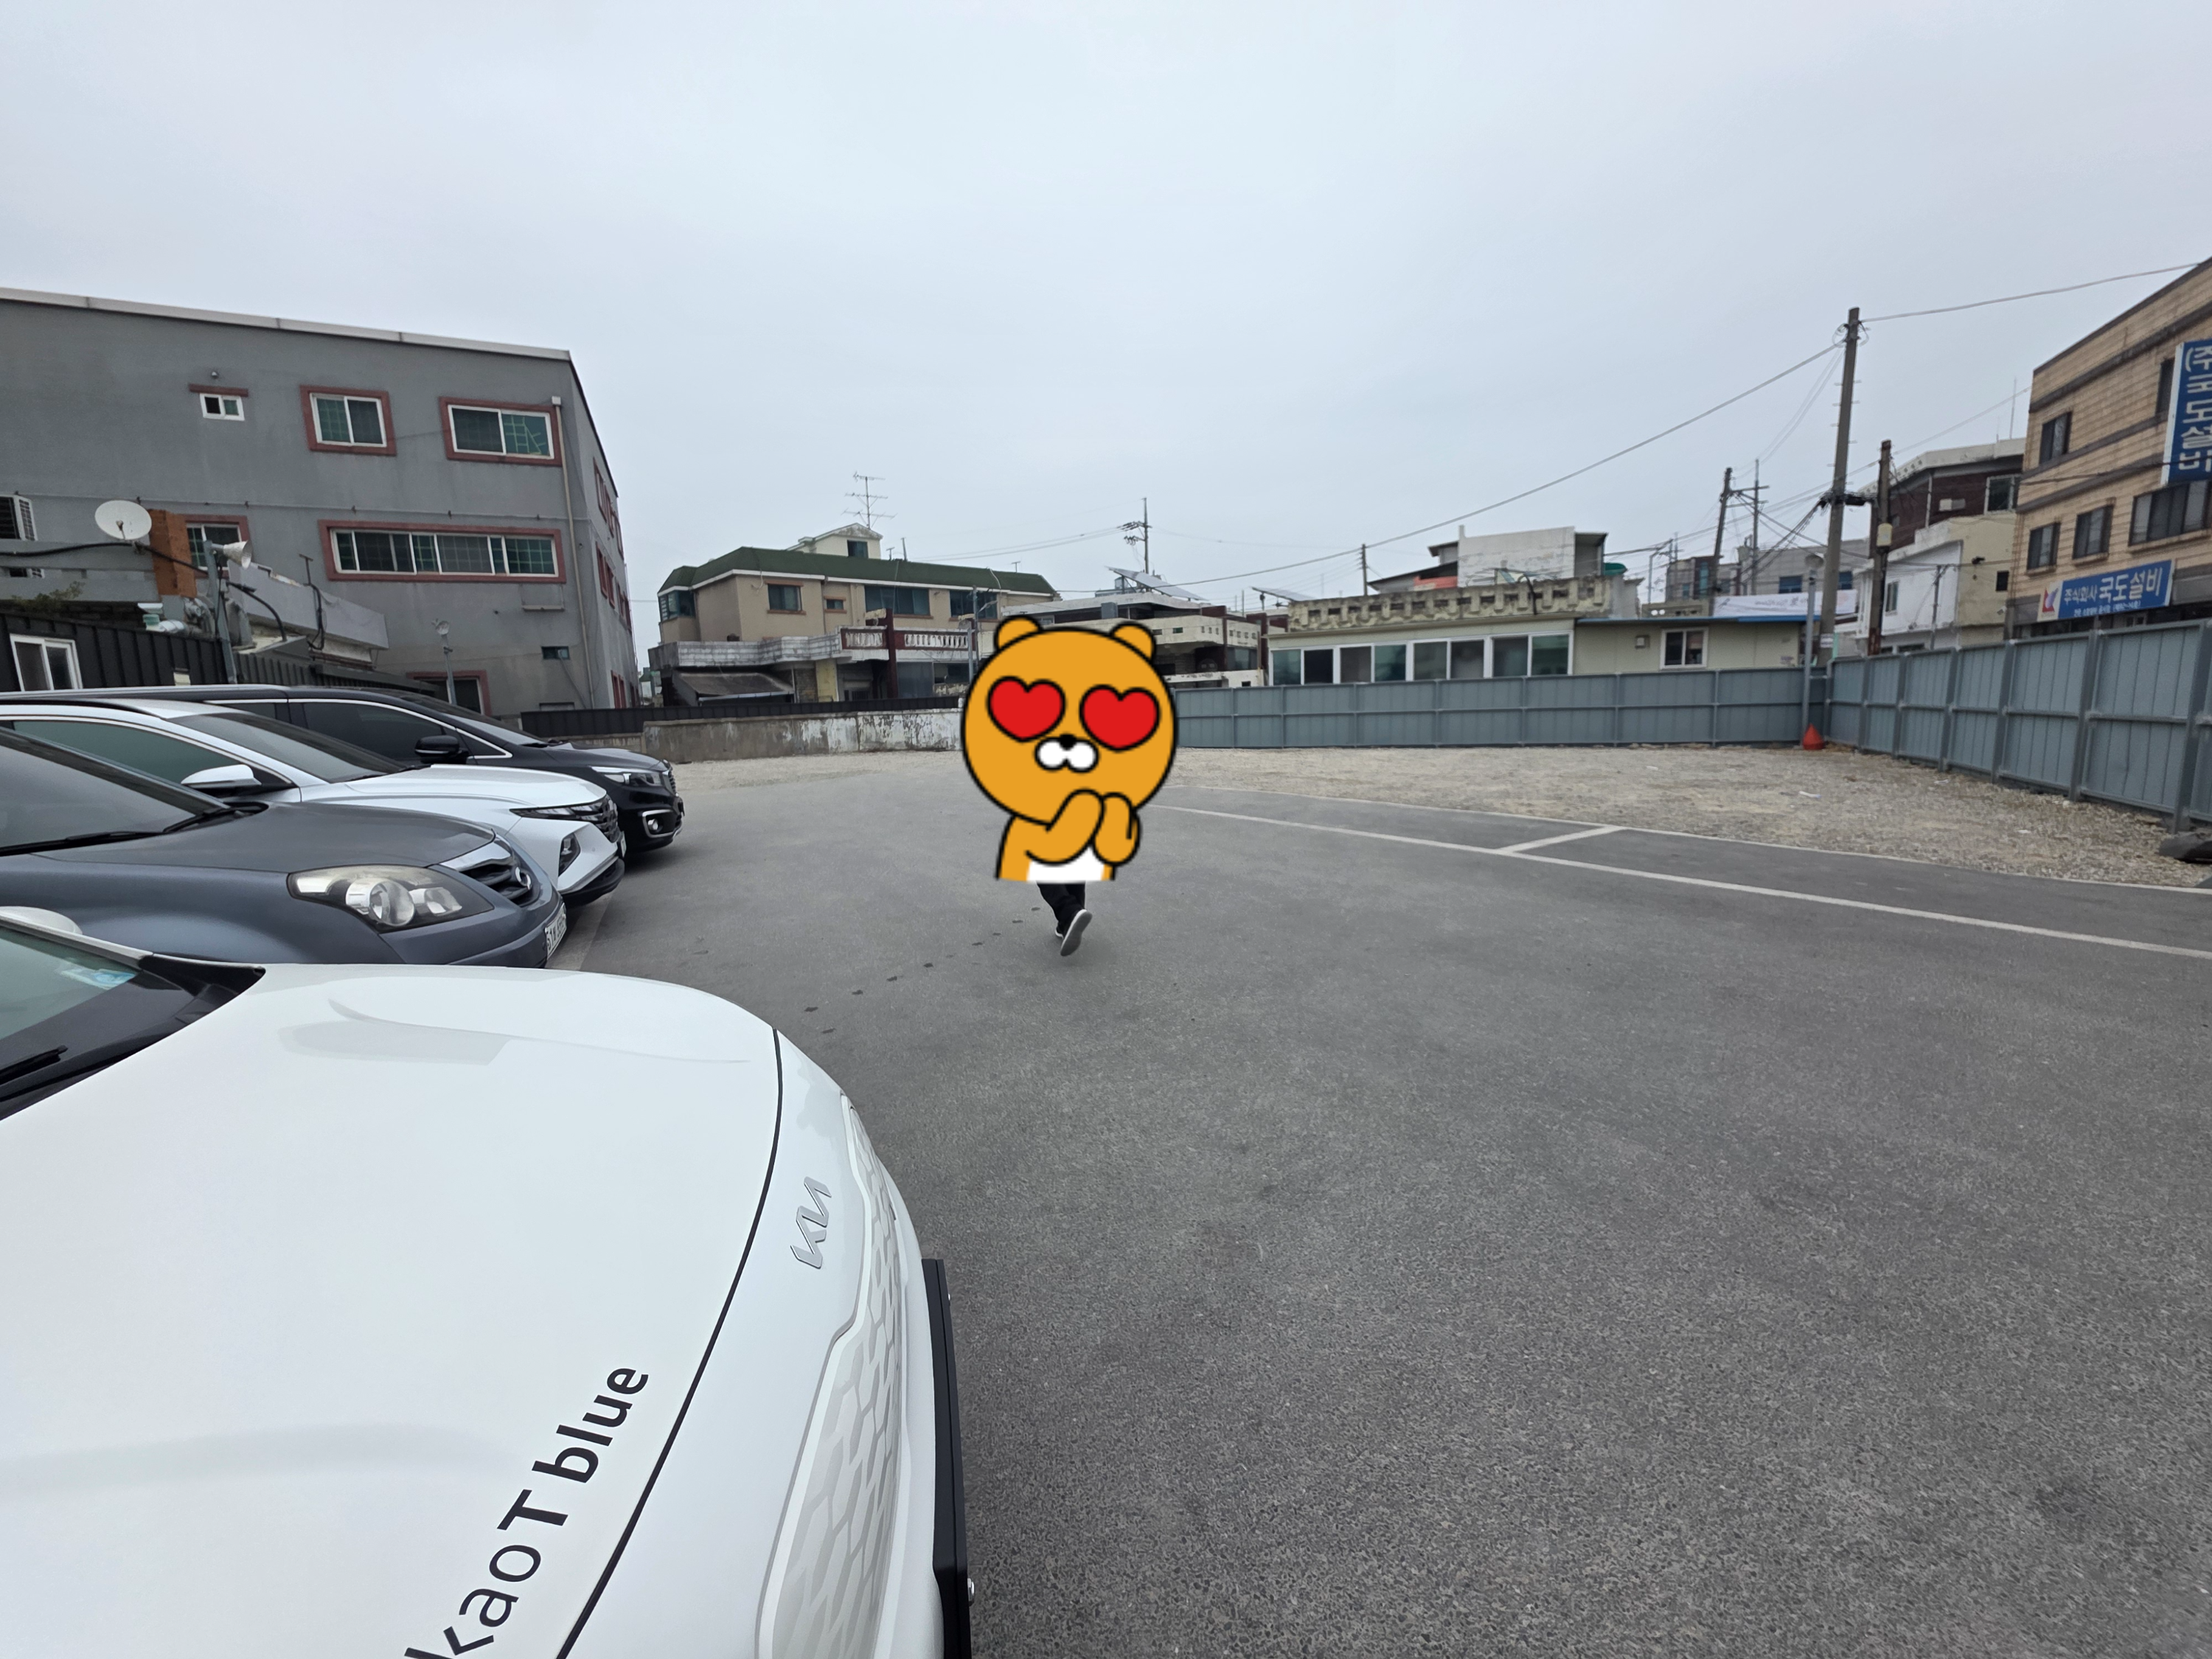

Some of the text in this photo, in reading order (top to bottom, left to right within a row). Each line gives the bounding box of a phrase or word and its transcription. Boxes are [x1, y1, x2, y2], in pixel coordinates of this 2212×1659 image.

[2063, 567, 2163, 605] 주식회사 국도설비
[531, 1368, 649, 1484] blue
